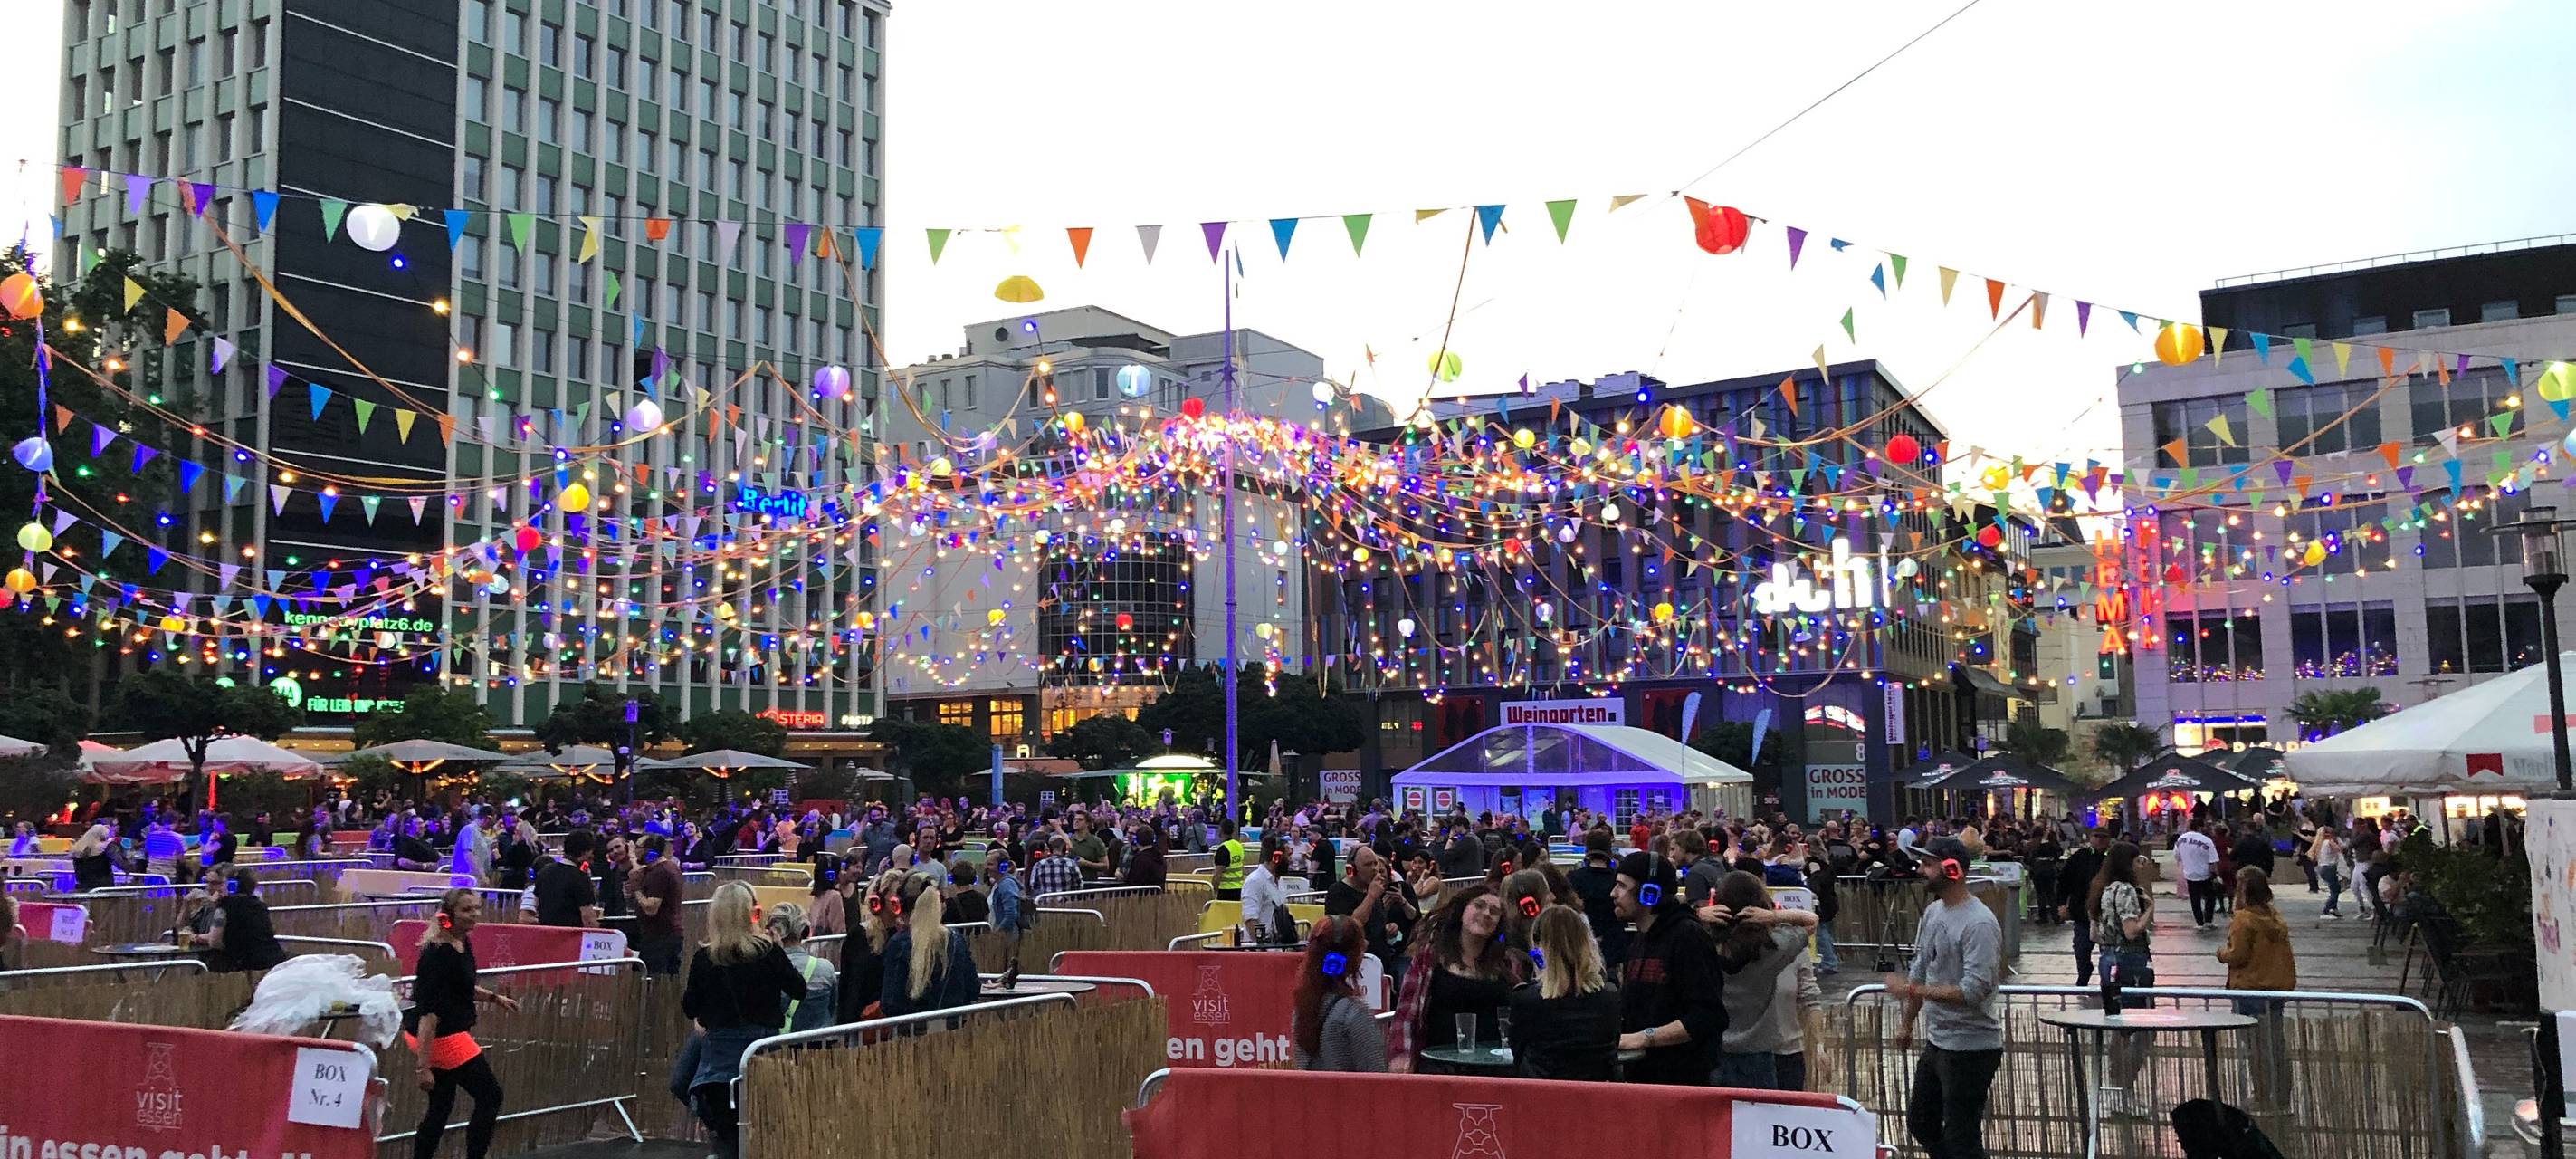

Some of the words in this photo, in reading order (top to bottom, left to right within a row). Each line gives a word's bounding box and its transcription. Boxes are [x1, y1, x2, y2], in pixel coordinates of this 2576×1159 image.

[742, 486, 807, 518] Berlit
[2094, 528, 2126, 654] HEMA
[1323, 771, 1361, 783] GROSS
[1810, 769, 1865, 784] GROSS
[1811, 786, 1824, 799] in
[1827, 786, 1866, 799] MODE
[1783, 895, 1802, 903] BOX
[593, 940, 614, 952] BOX
[1192, 994, 1230, 1013] visit
[1193, 1010, 1231, 1022] essen
[1214, 1031, 1291, 1067] geht
[314, 1063, 348, 1083] BOX
[137, 1086, 183, 1113] visit
[310, 1088, 331, 1107] Nr.
[333, 1092, 343, 1108] 4
[137, 1107, 182, 1125] essen
[1771, 1124, 1834, 1153] BOX
